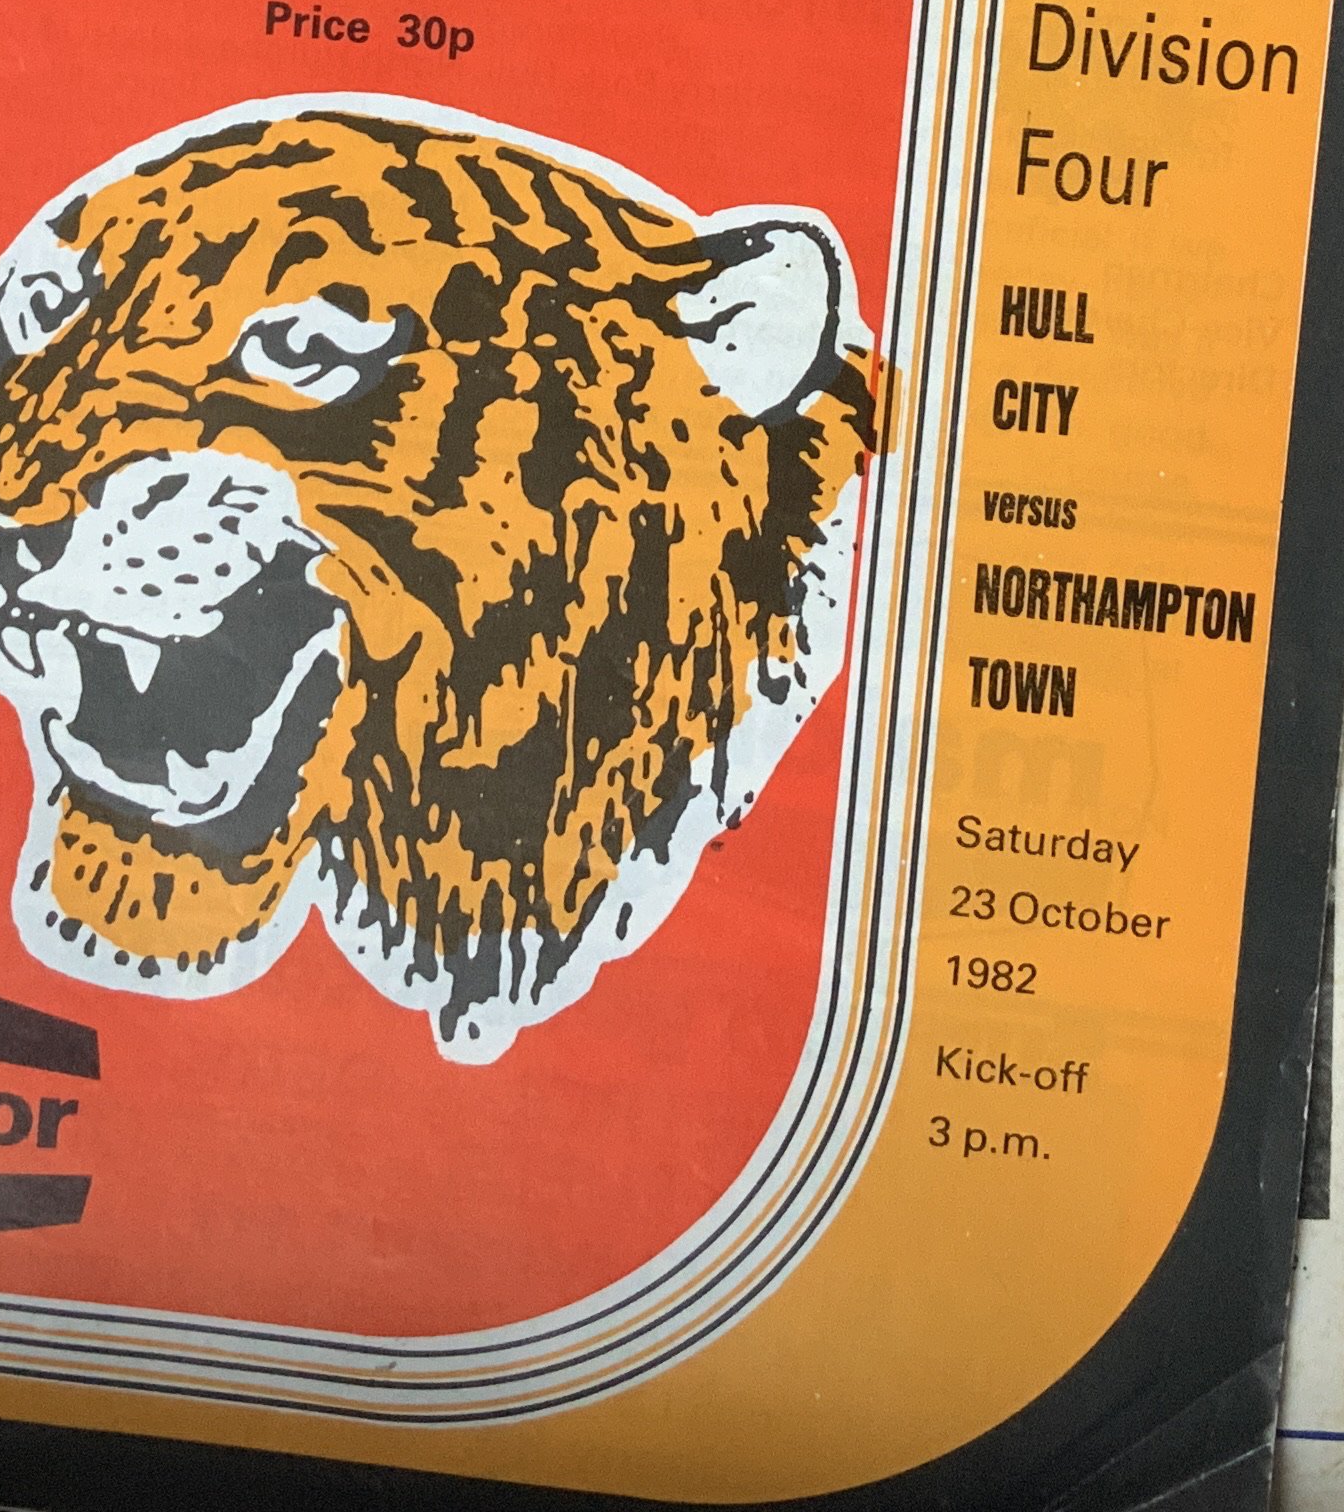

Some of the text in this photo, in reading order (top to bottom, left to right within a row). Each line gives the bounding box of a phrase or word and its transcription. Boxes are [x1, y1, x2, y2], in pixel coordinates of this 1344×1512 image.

[265, 1, 475, 59] Price 30p
[1028, 2, 1299, 95] Division
[1016, 127, 1168, 208] Four
[1000, 284, 1095, 344] HULL
[992, 378, 1079, 436] CITY
[983, 490, 1078, 530] versus
[973, 562, 1255, 643] NORTHAMPTON
[969, 656, 1077, 717] TOWN
[955, 814, 1140, 873] Saturday
[949, 885, 1171, 939] 23 October
[946, 955, 1038, 995] 1982
[935, 1045, 1090, 1094] Kick-off
[928, 1116, 1051, 1160] 3 p.m.
